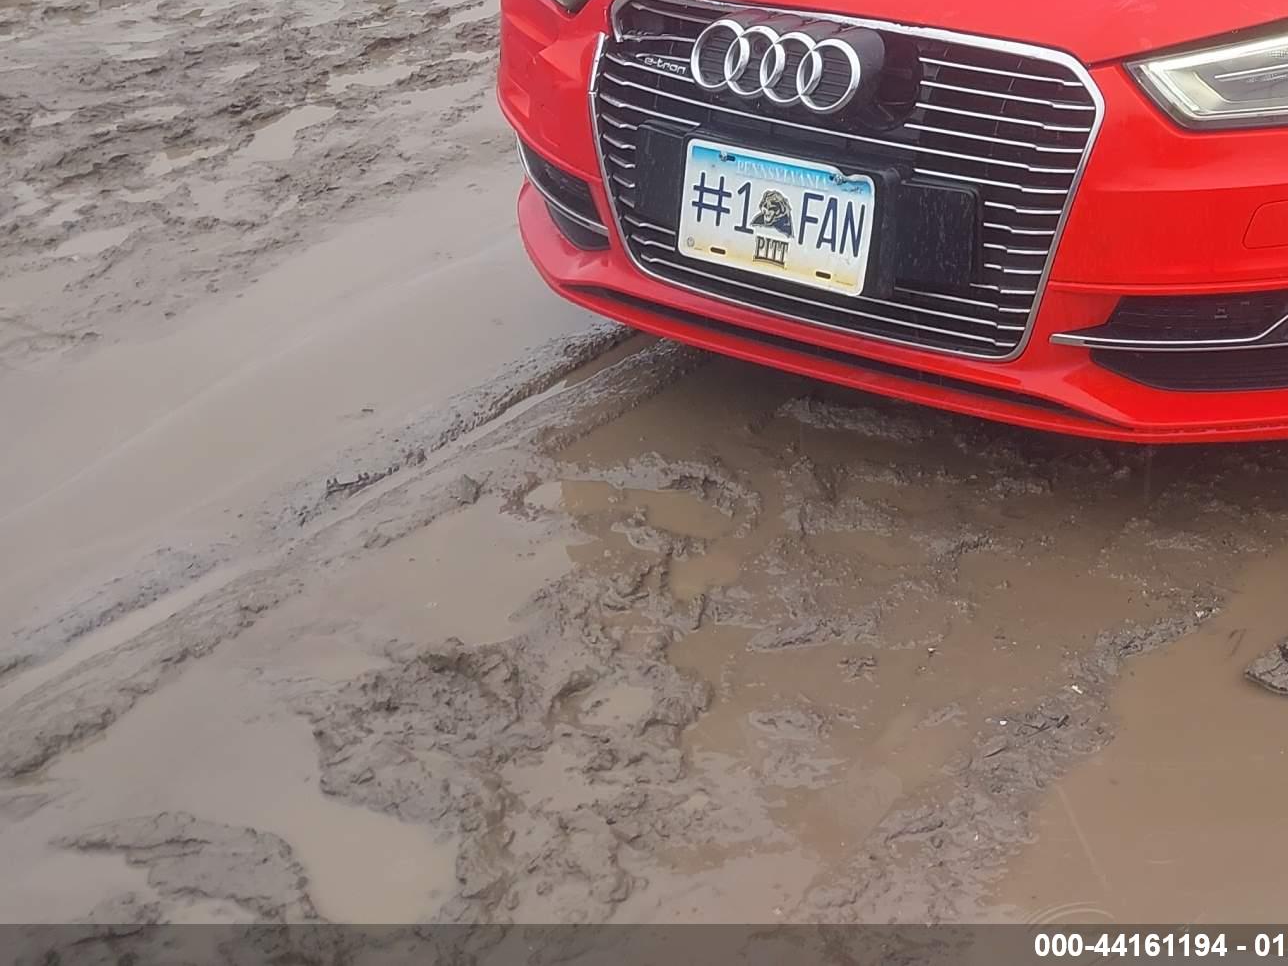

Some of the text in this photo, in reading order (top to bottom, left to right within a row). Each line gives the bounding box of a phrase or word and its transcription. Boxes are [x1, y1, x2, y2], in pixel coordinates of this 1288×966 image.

[644, 56, 687, 75] e-tron
[736, 159, 829, 190] PENNSYLVANIA
[691, 171, 867, 258] #1 FAN
[755, 235, 790, 264] PITT
